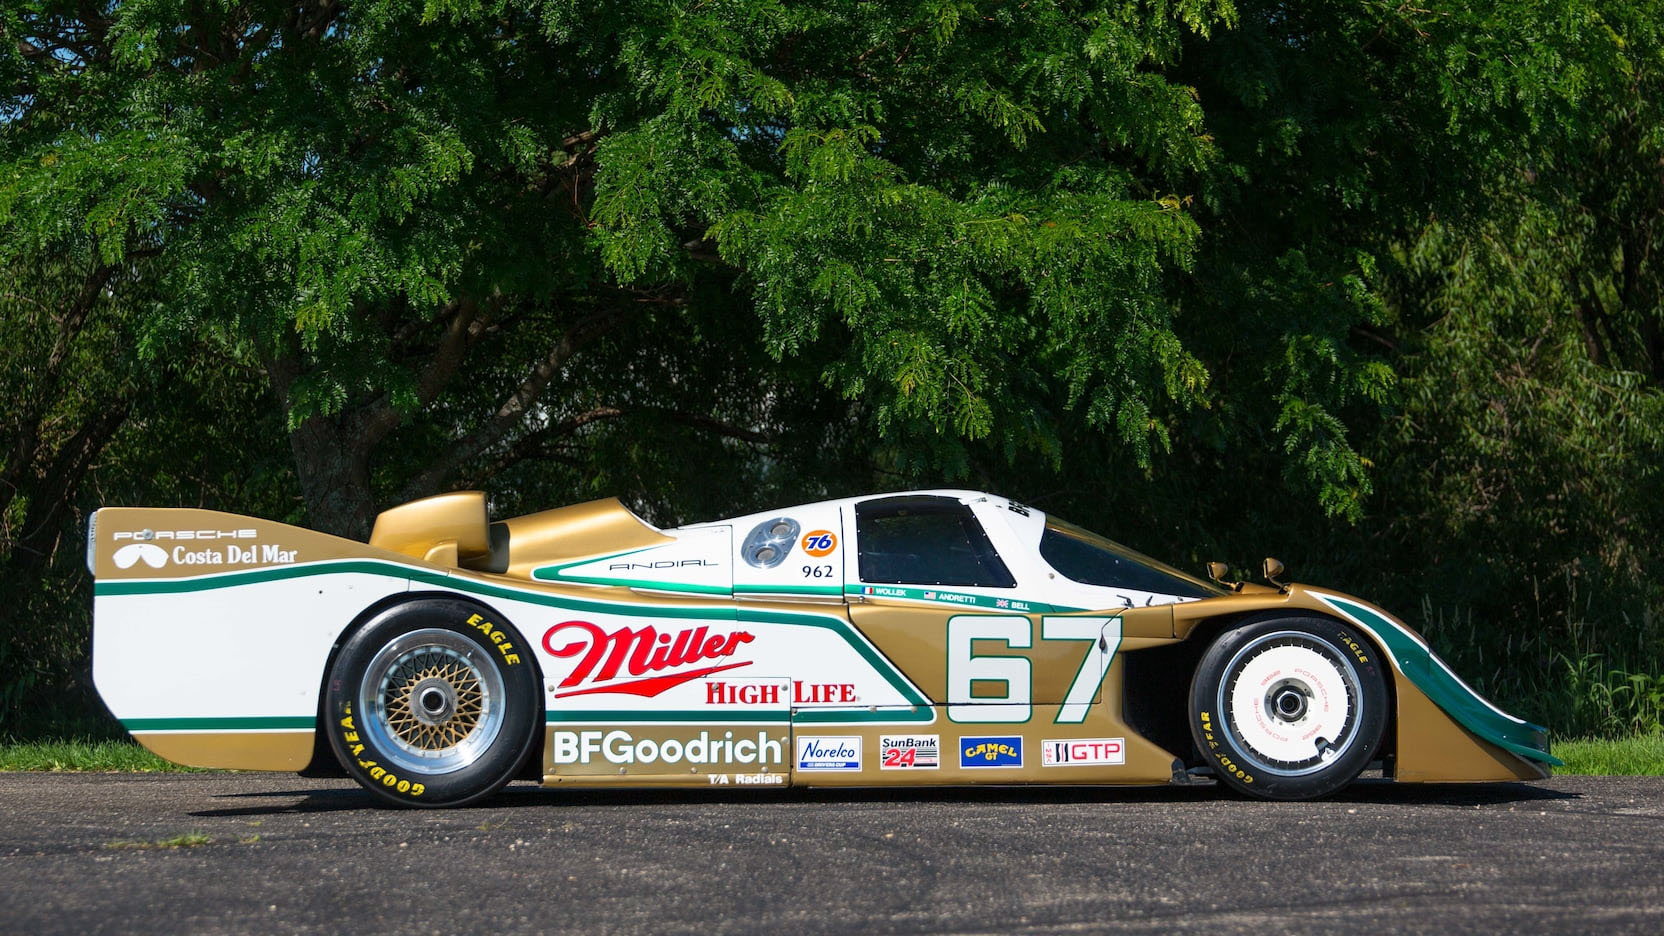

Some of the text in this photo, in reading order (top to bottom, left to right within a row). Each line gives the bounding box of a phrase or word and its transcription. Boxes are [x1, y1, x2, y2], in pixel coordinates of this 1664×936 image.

[113, 529, 257, 541] PORSCHE
[807, 534, 832, 550] 76
[172, 544, 297, 564] Costa Del Mar
[609, 559, 719, 571] ANDIAL
[802, 565, 833, 578] 962
[876, 588, 907, 597] WOLLEK
[938, 594, 976, 604] ANDRETTI
[1011, 601, 1030, 611] BELL
[467, 612, 521, 666] EAGLE
[542, 620, 756, 690] Miller
[946, 614, 1124, 724] 67
[705, 681, 856, 704] HIGH LIFE
[1294, 667, 1329, 713] PORSCHE
[554, 730, 783, 765] BFGoodrich
[801, 739, 855, 761] Norelco
[882, 738, 937, 748] SunBank
[965, 743, 1017, 758] CAMEL
[884, 748, 916, 767] 24
[985, 752, 998, 761] GT
[1071, 743, 1121, 760] GTP
[708, 773, 783, 785] T/A Radials
